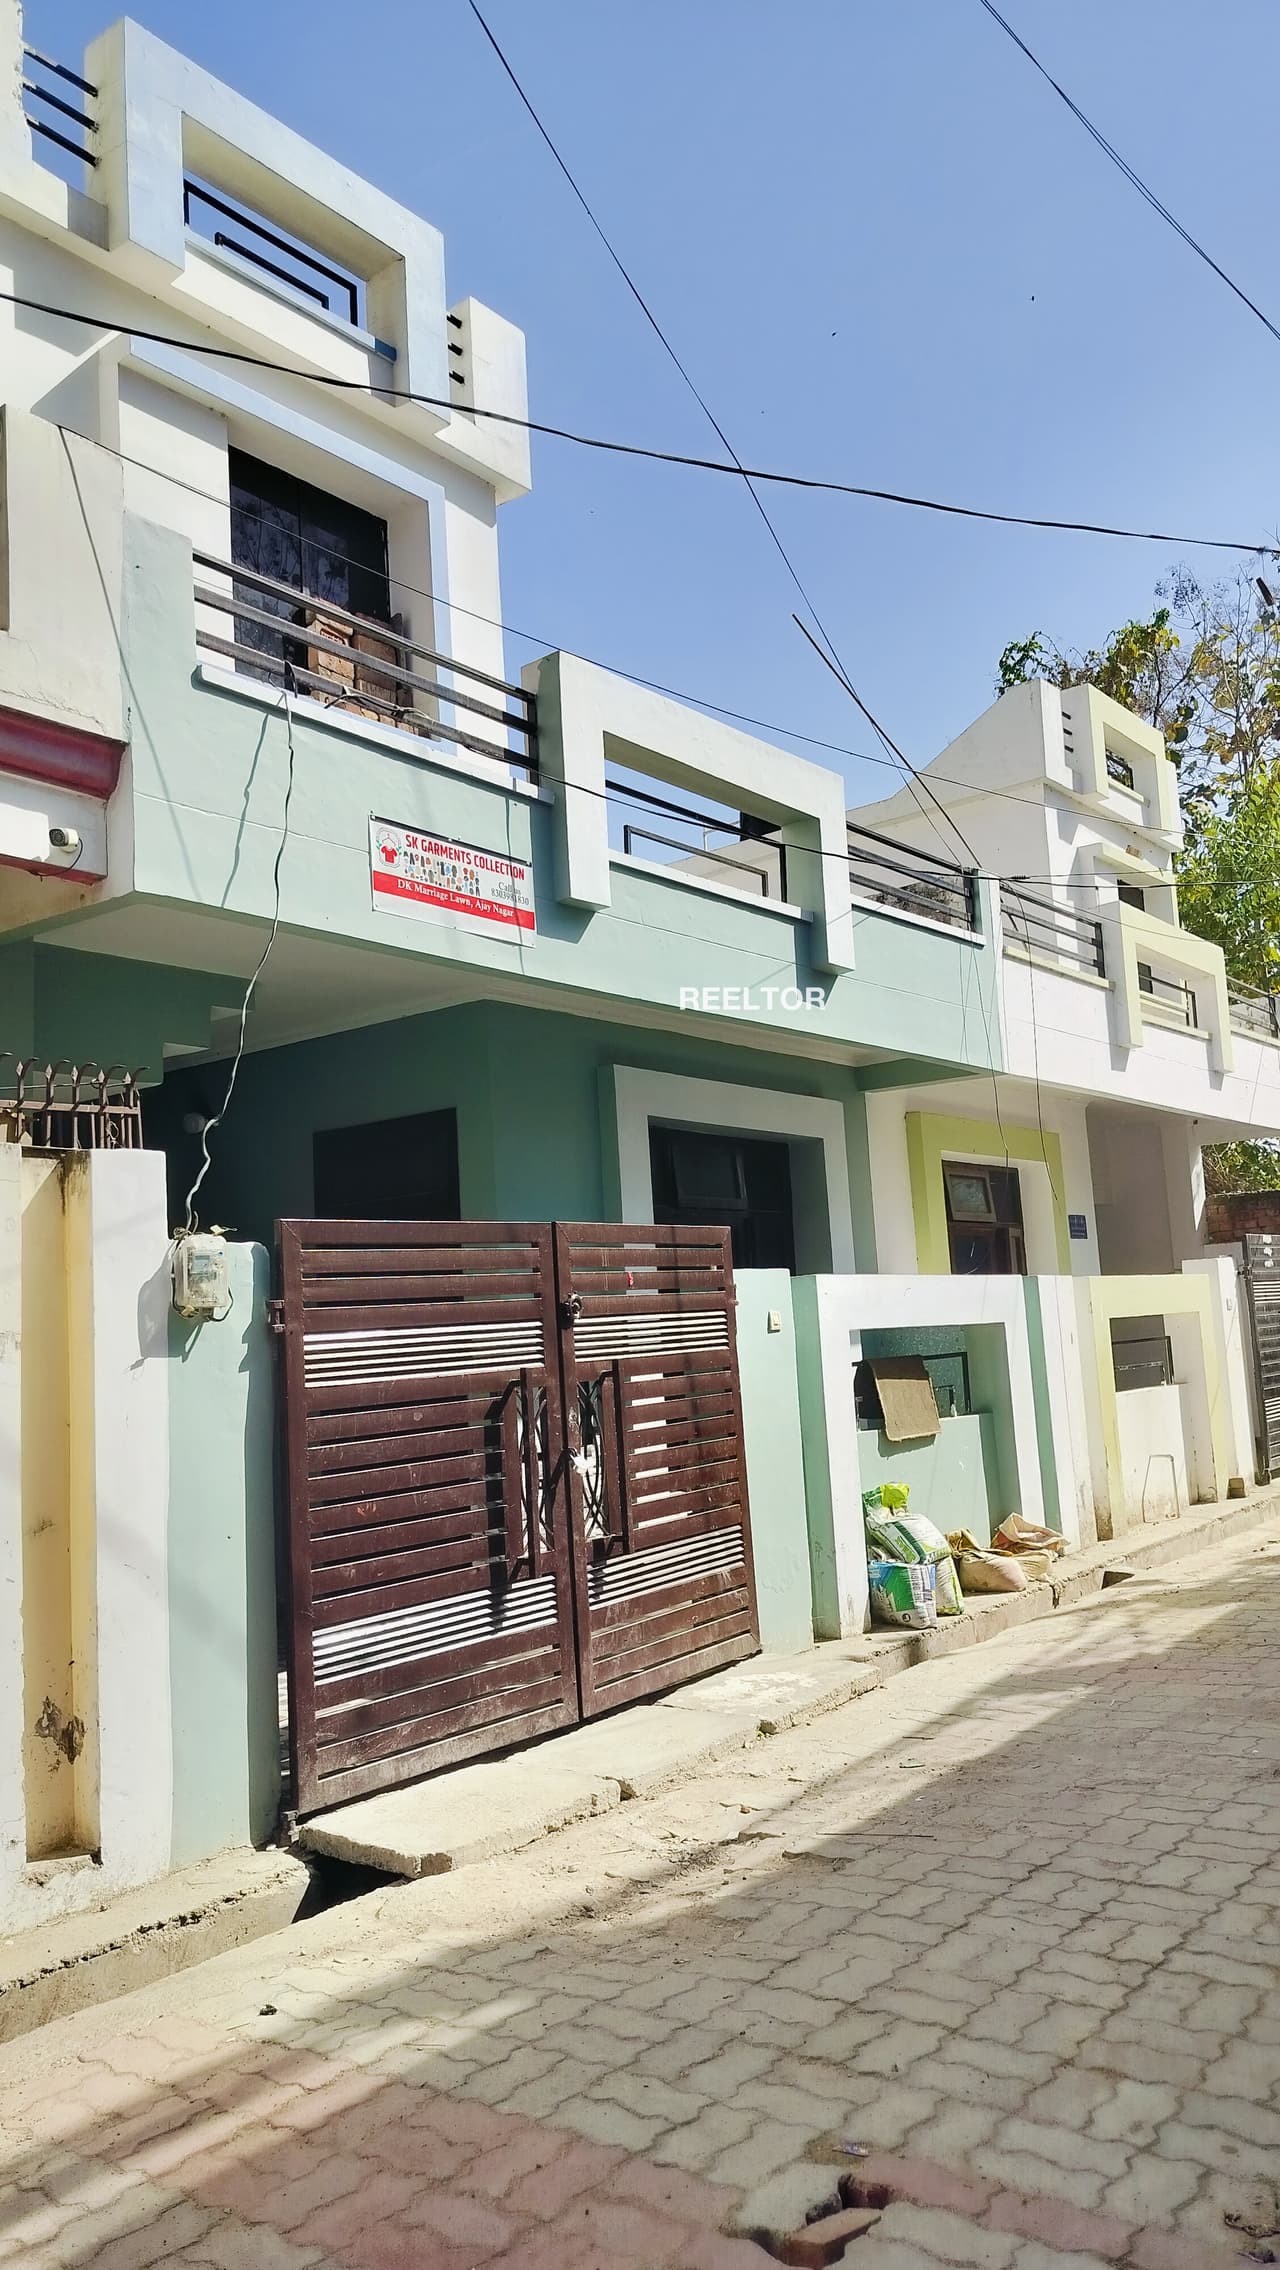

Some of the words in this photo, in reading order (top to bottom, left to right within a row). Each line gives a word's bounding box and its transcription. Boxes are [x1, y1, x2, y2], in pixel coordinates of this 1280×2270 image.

[405, 834, 419, 850] SK
[421, 839, 471, 865] GARMENTS
[474, 855, 525, 881] COLLECTION
[398, 879, 413, 891] DK
[414, 884, 449, 901] Marriage
[450, 893, 474, 908] Lawn,
[475, 899, 492, 912] Ajay
[493, 903, 514, 917] Nagar
[498, 881, 513, 893] Call
